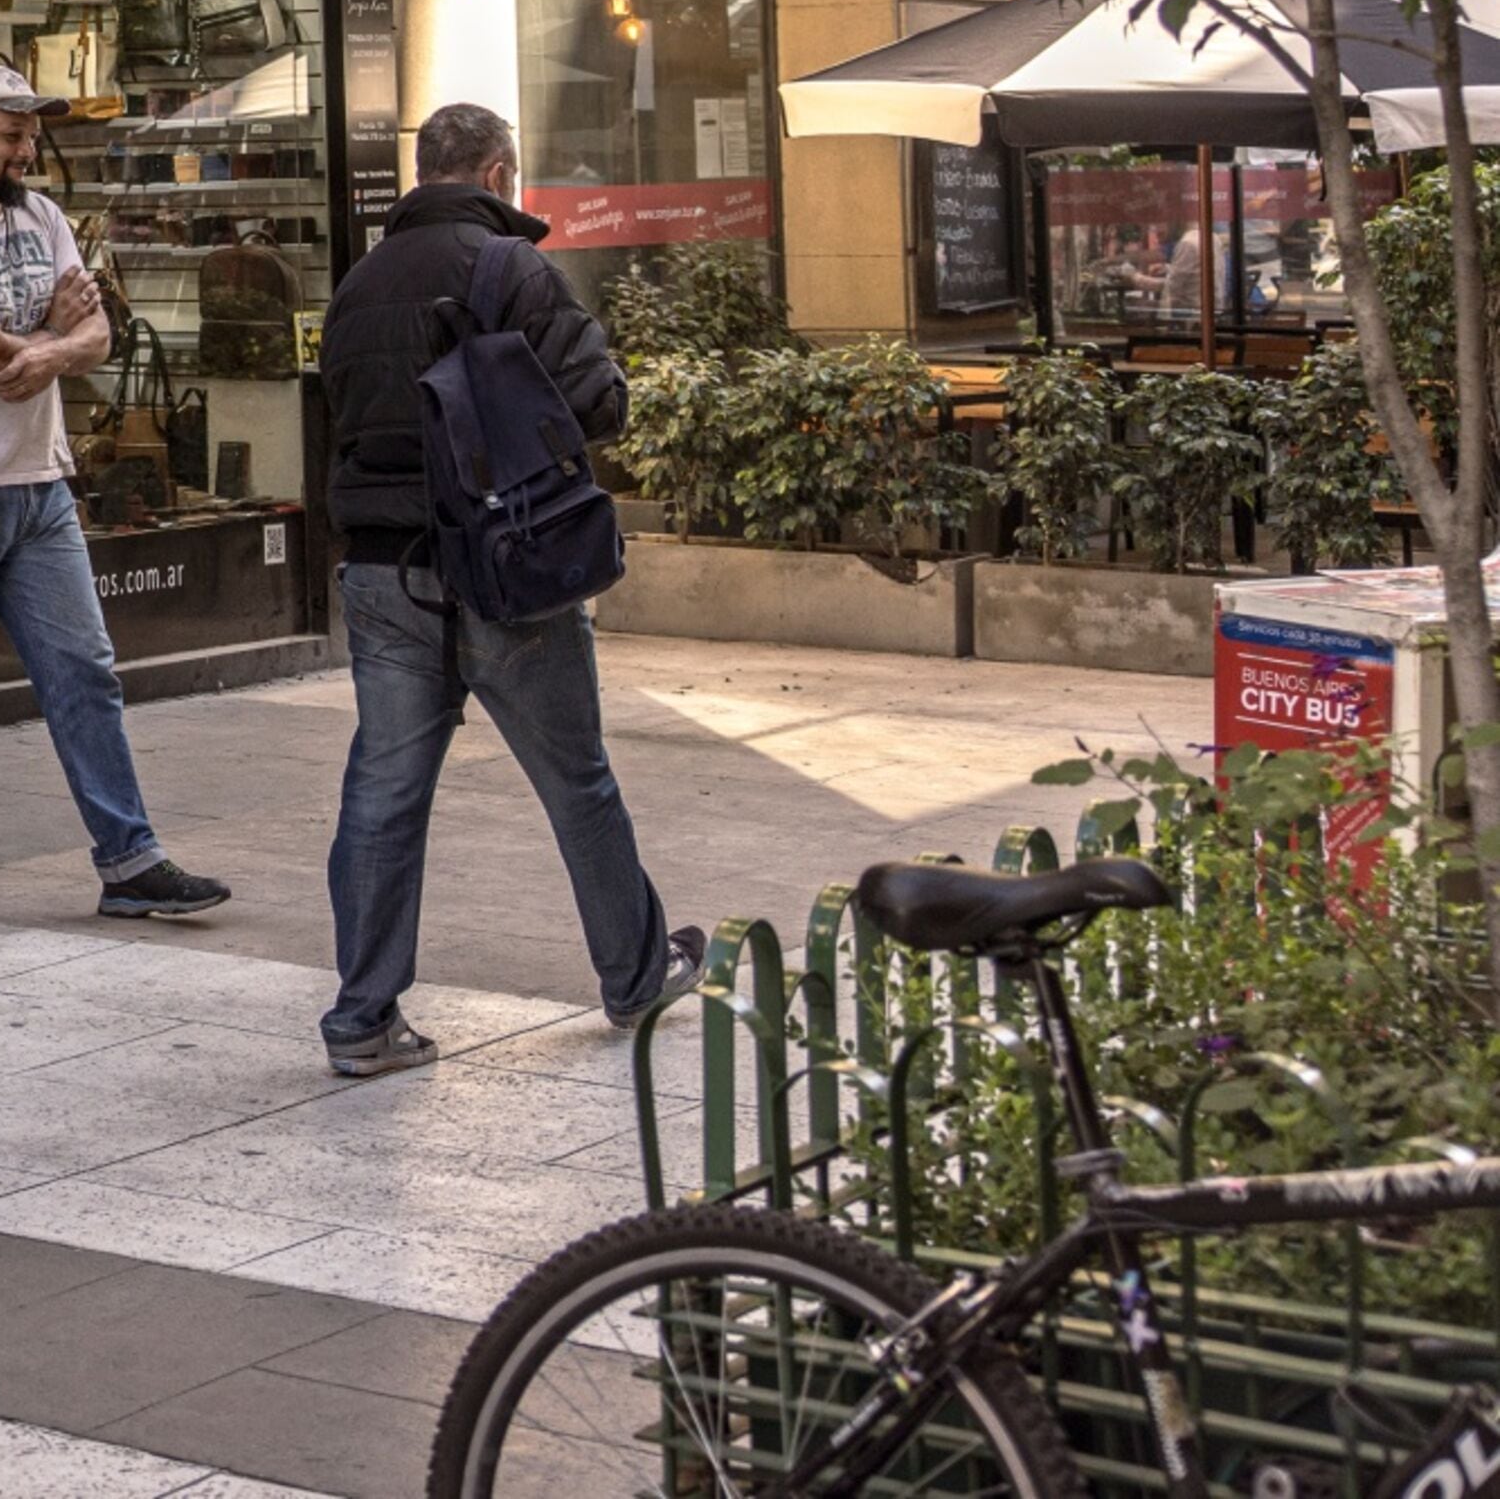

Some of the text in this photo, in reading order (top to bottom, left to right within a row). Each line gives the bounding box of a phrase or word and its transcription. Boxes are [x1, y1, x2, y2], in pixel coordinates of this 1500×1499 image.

[1238, 621, 1280, 638] Servicios
[1281, 627, 1307, 641] cada
[1242, 667, 1309, 692] BUENOS
[1241, 688, 1360, 729] CITY BUS
